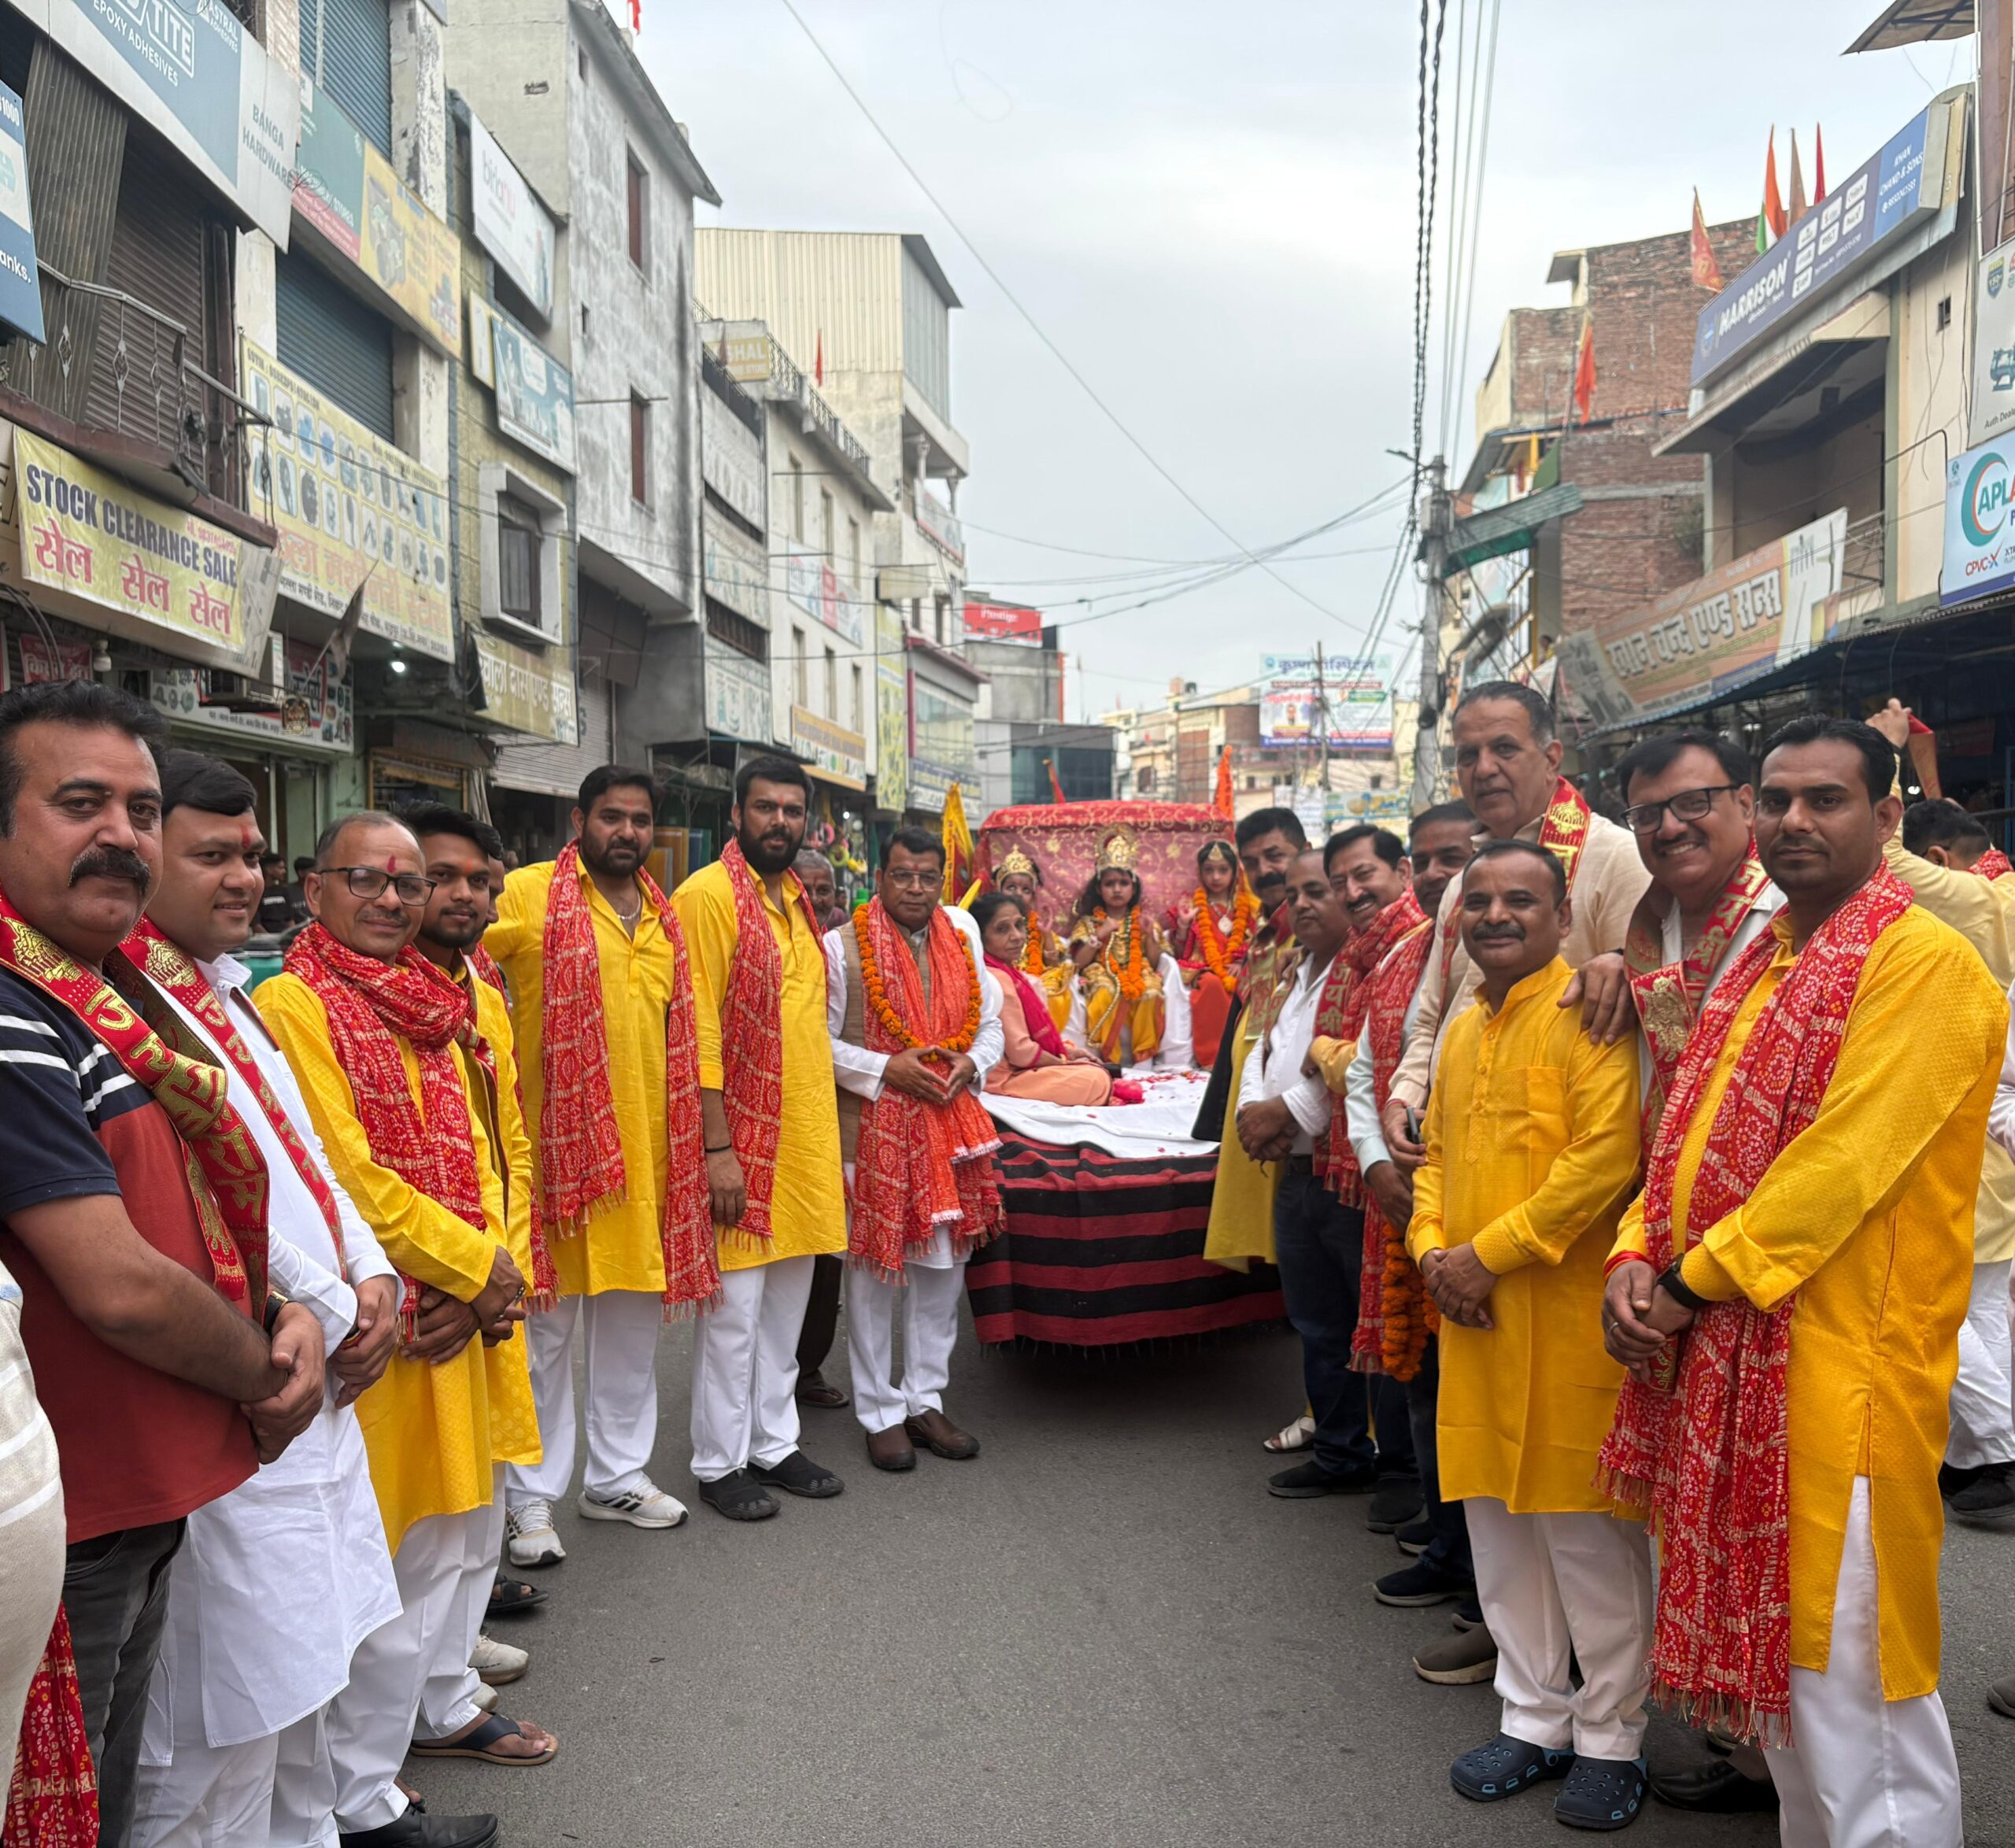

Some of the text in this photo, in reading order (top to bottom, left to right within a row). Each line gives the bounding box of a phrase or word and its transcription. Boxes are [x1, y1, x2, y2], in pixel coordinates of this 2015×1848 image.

[93, 0, 179, 87] EPOXY ADHESIVES
[208, 0, 238, 43] ASTRAL
[0, 95, 20, 127] 1000
[252, 103, 284, 151] BANGA
[242, 126, 294, 190] HARDWARE
[1718, 257, 1788, 337] HARRISON
[1984, 415, 1999, 430] Auth
[26, 463, 98, 529] STOCK
[102, 498, 201, 574] CLEARANCE
[202, 546, 237, 589] SALE
[33, 516, 231, 635] सेल सेल सेल
[1605, 631, 1658, 679] खान
[1649, 612, 1695, 663] चन्द
[1688, 591, 1734, 649] एण्ड
[1732, 567, 1783, 630] सन्स
